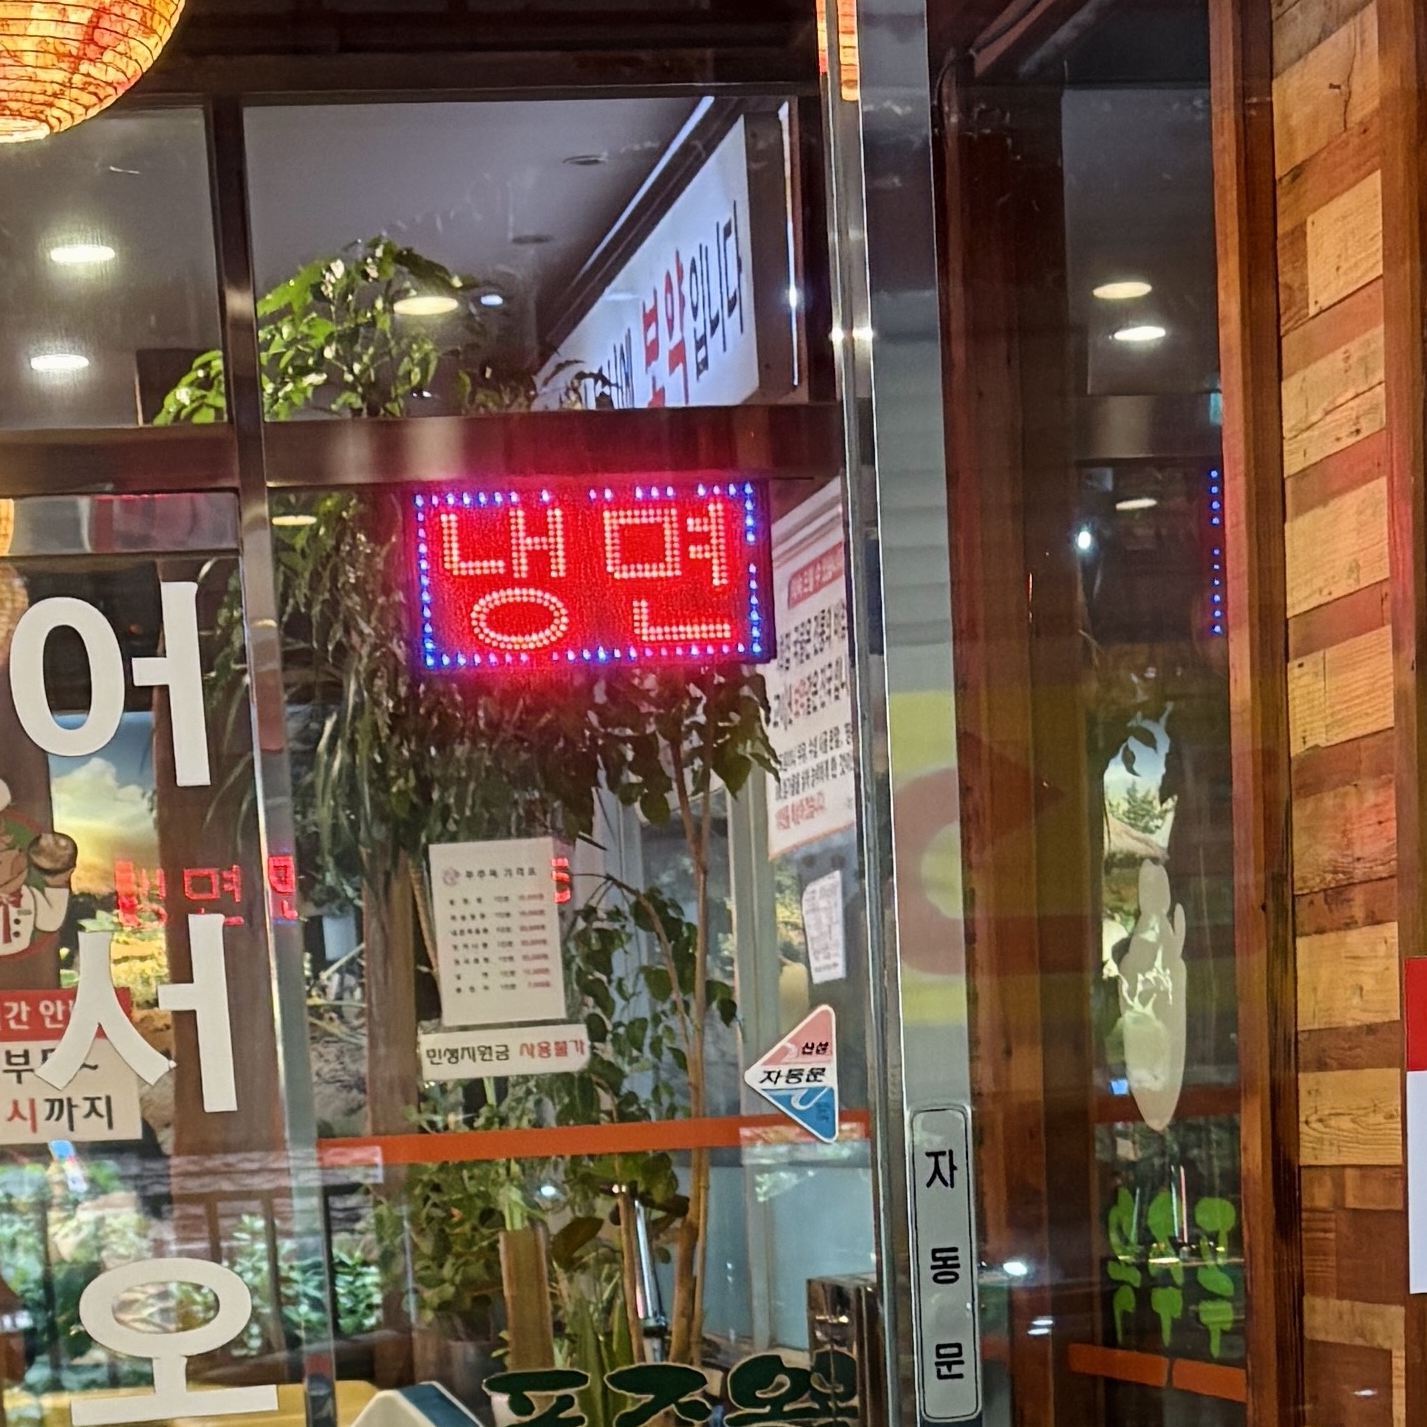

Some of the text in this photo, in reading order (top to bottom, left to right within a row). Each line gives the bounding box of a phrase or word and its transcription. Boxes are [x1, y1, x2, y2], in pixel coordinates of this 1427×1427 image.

[440, 502, 732, 651] 냉면
[38, 1000, 74, 1029] 안
[426, 1038, 585, 1065] 민생지원금 사용불가
[759, 1066, 827, 1086] 자동문
[925, 1149, 965, 1380] 자동문
